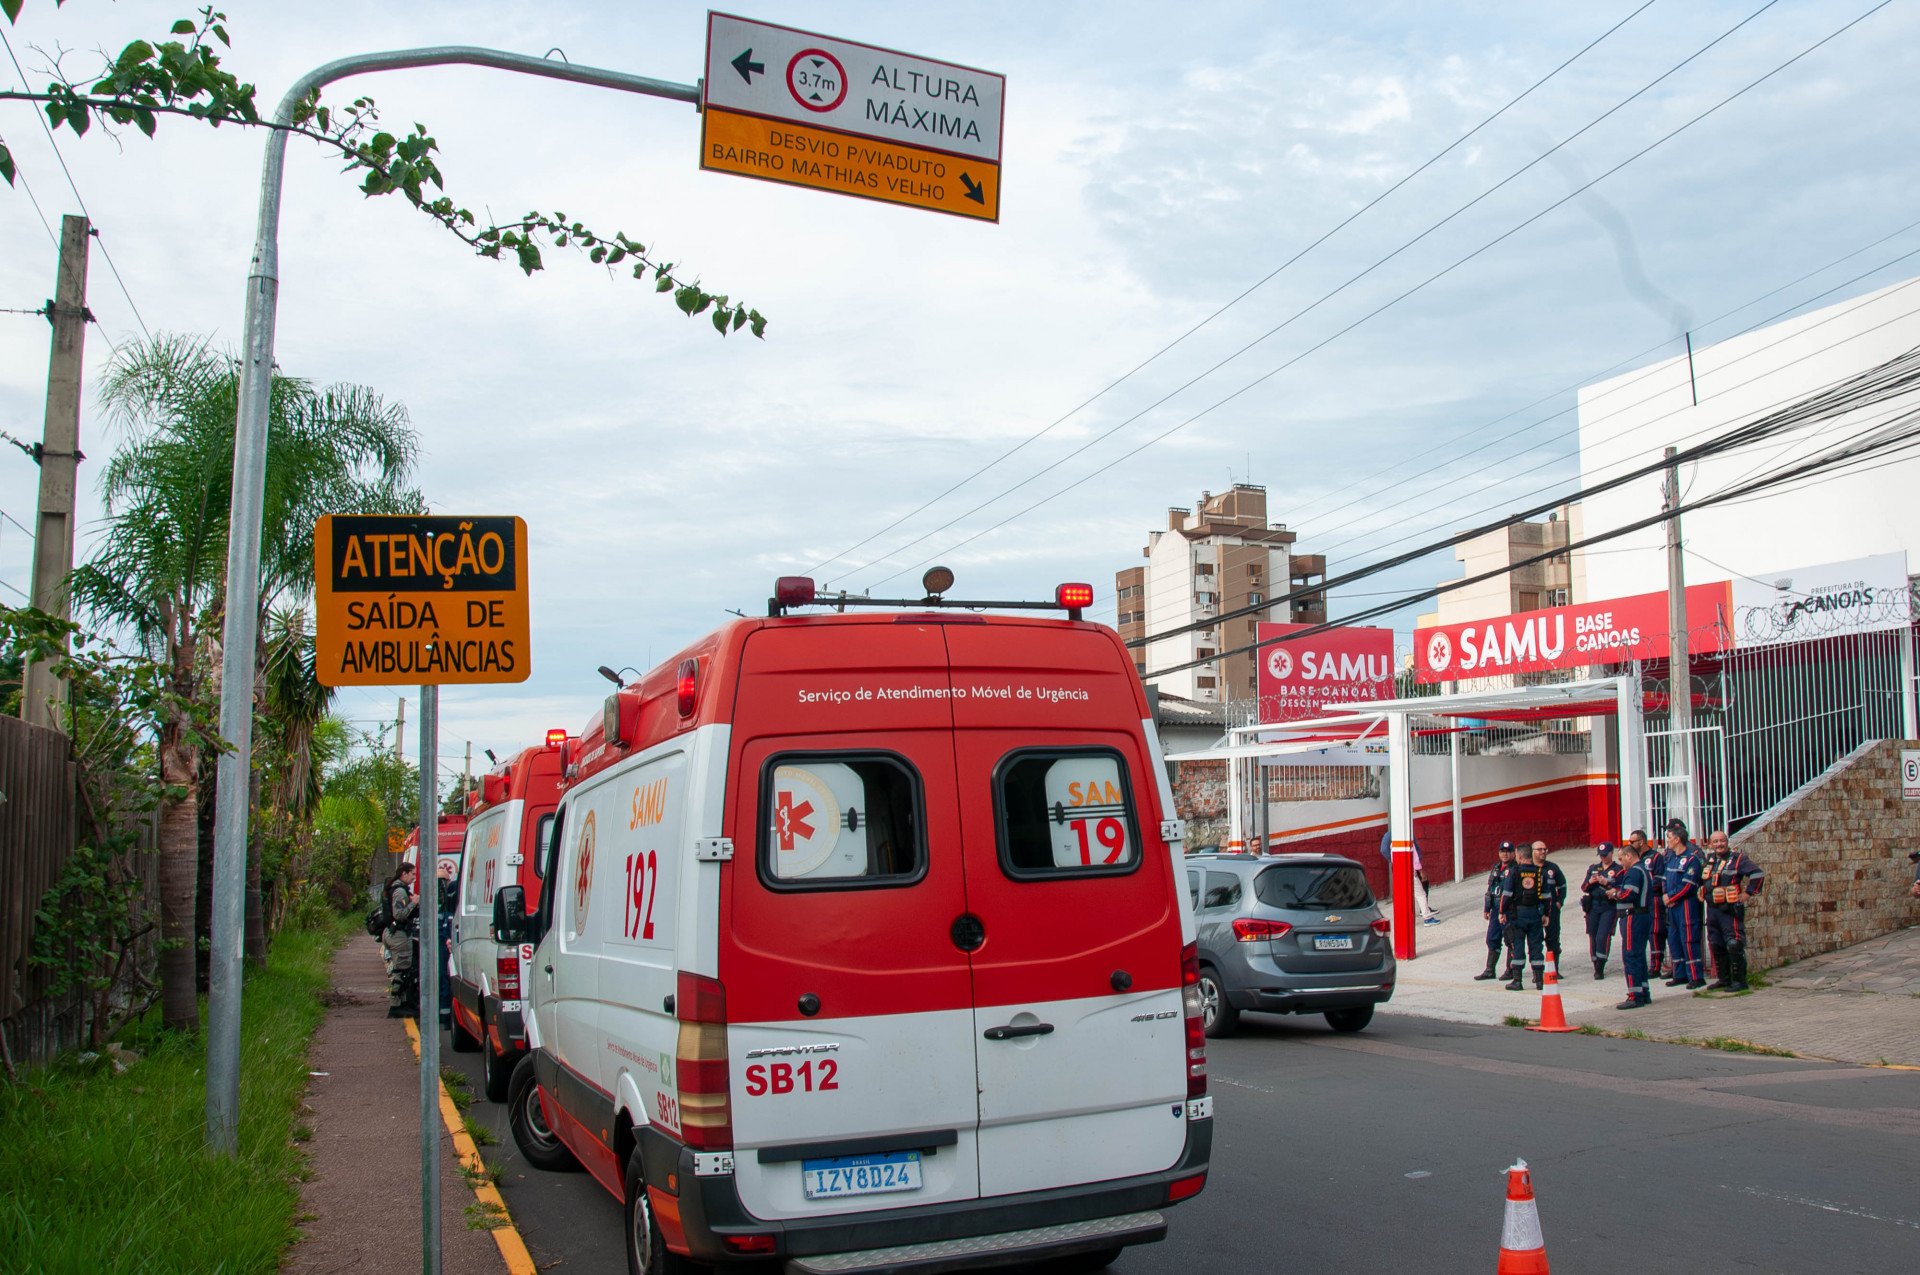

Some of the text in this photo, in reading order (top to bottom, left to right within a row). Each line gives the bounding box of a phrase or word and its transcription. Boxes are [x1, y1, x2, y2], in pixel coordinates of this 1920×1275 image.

[798, 71, 835, 92] 3.7m
[871, 64, 980, 107] ALTURA
[866, 98, 981, 143] MÁXIMA
[713, 144, 945, 201] BAIRRO MATHIAS VELHO
[770, 130, 946, 178] DESVIO P/VIADUTO
[341, 521, 505, 589] ATENÇÃO
[1804, 588, 1874, 613] CANOAS
[1811, 582, 1852, 594] PREFEITURA
[347, 593, 505, 630] SAÍDA DE
[1575, 612, 1613, 634] BASE
[340, 632, 515, 673] AMBULÂNCIAS
[1460, 613, 1565, 670] SAMU
[1575, 628, 1640, 652] CANOAS
[1301, 651, 1388, 683] SAMU
[798, 685, 1089, 704] Serviço de Atendimento Móvel de Urgência
[1280, 685, 1315, 696] BASE
[1908, 764, 1915, 777] E
[630, 776, 668, 831] SAMU
[624, 850, 657, 941] 192
[746, 1043, 840, 1058] SPRINTER
[746, 1059, 839, 1096] SB12
[657, 1091, 679, 1129] SB12
[816, 1164, 909, 1193] IZY8D24
